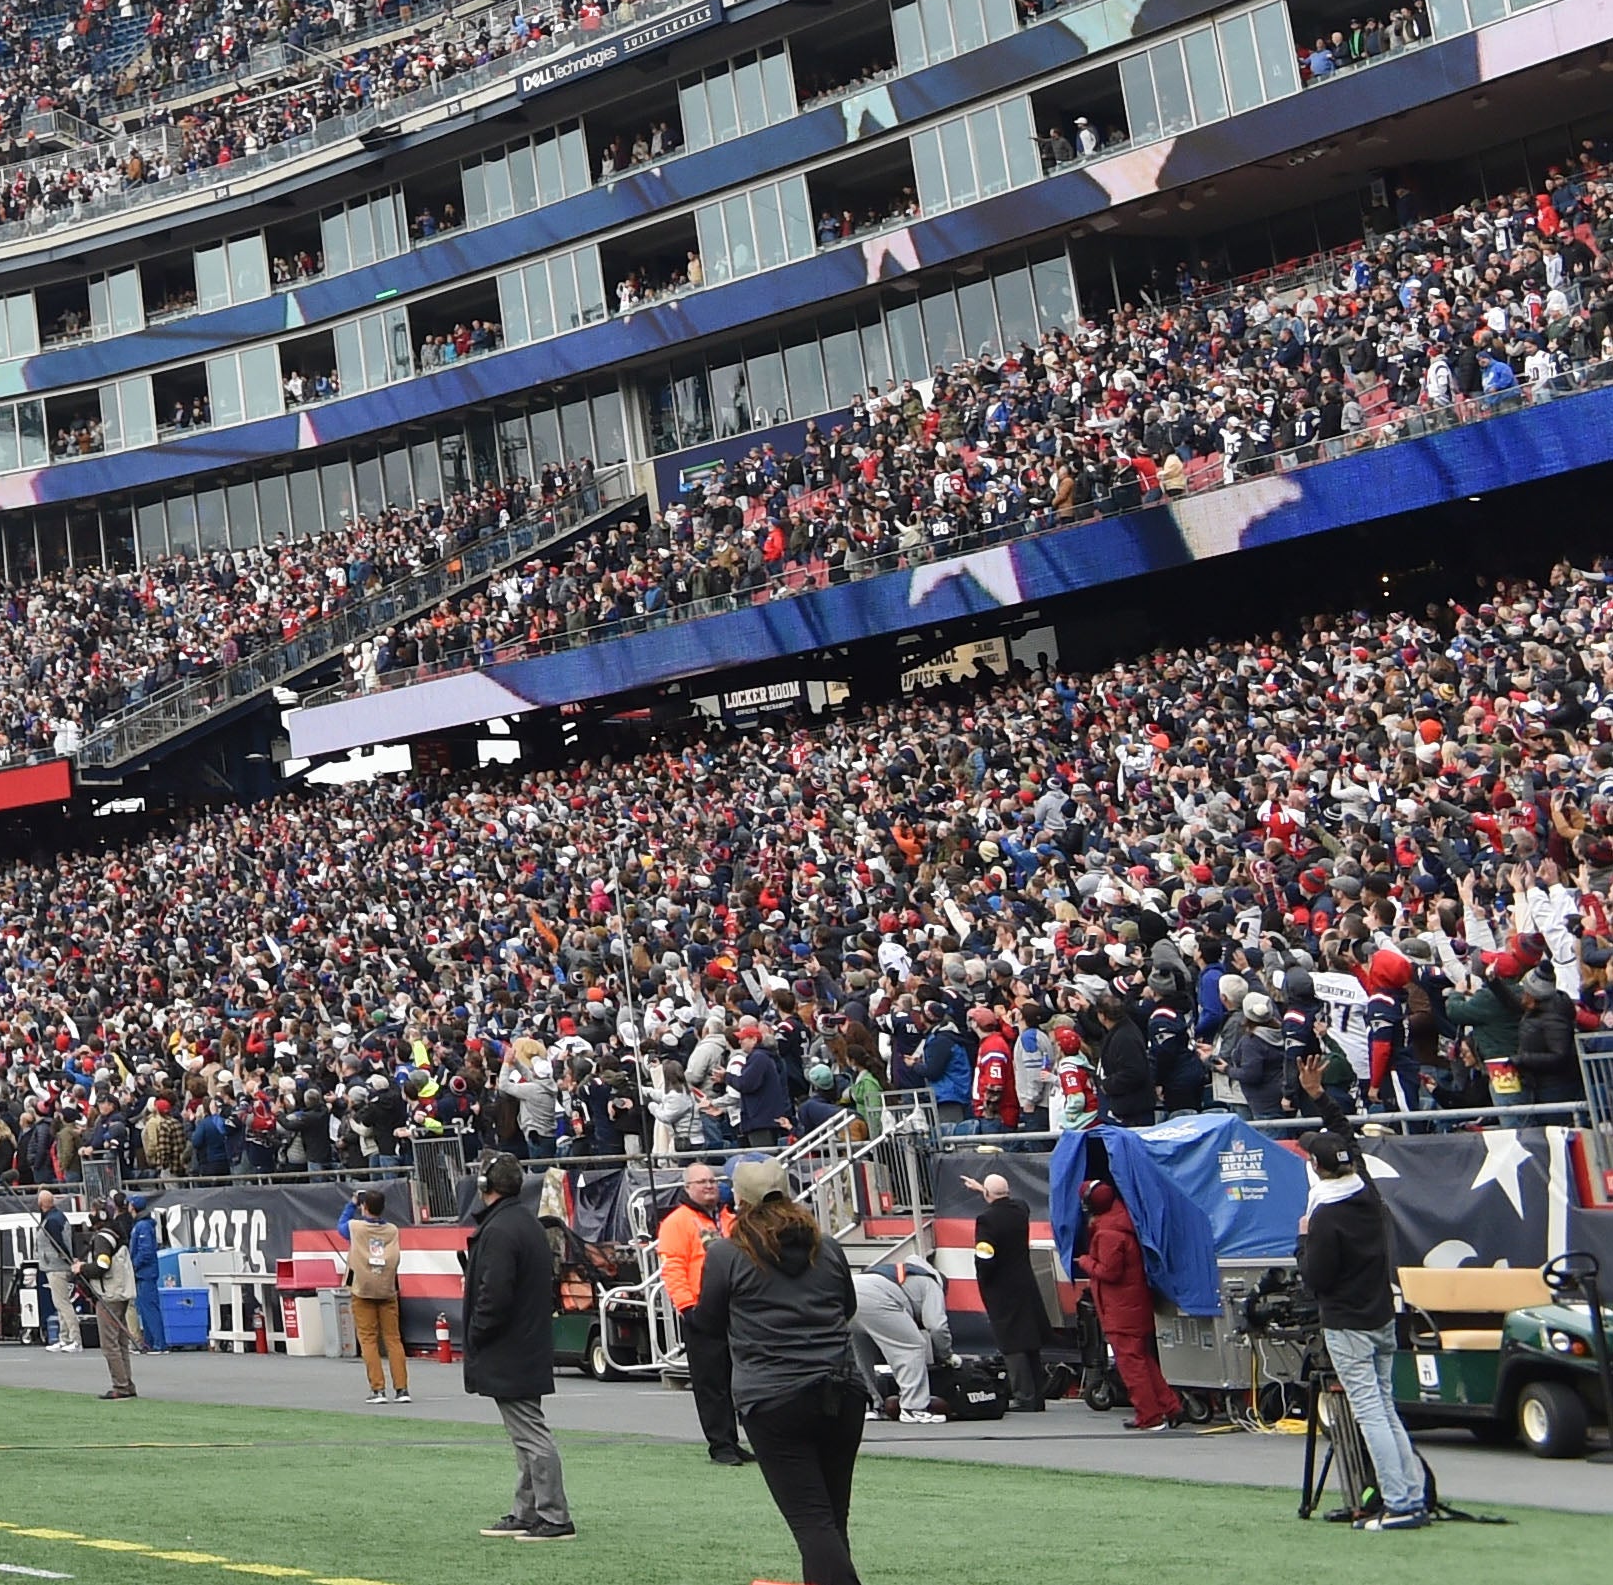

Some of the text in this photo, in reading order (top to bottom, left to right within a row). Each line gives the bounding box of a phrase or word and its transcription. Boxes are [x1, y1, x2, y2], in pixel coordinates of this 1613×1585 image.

[623, 7, 712, 50] SUITE LEVELS
[522, 44, 618, 93] DELL Technologies
[723, 686, 768, 709] LOCKER
[767, 680, 801, 702] ROOM
[989, 1065, 1003, 1079] 51
[1218, 1152, 1264, 1164] INSTANT
[1221, 1161, 1262, 1172] REPLAY
